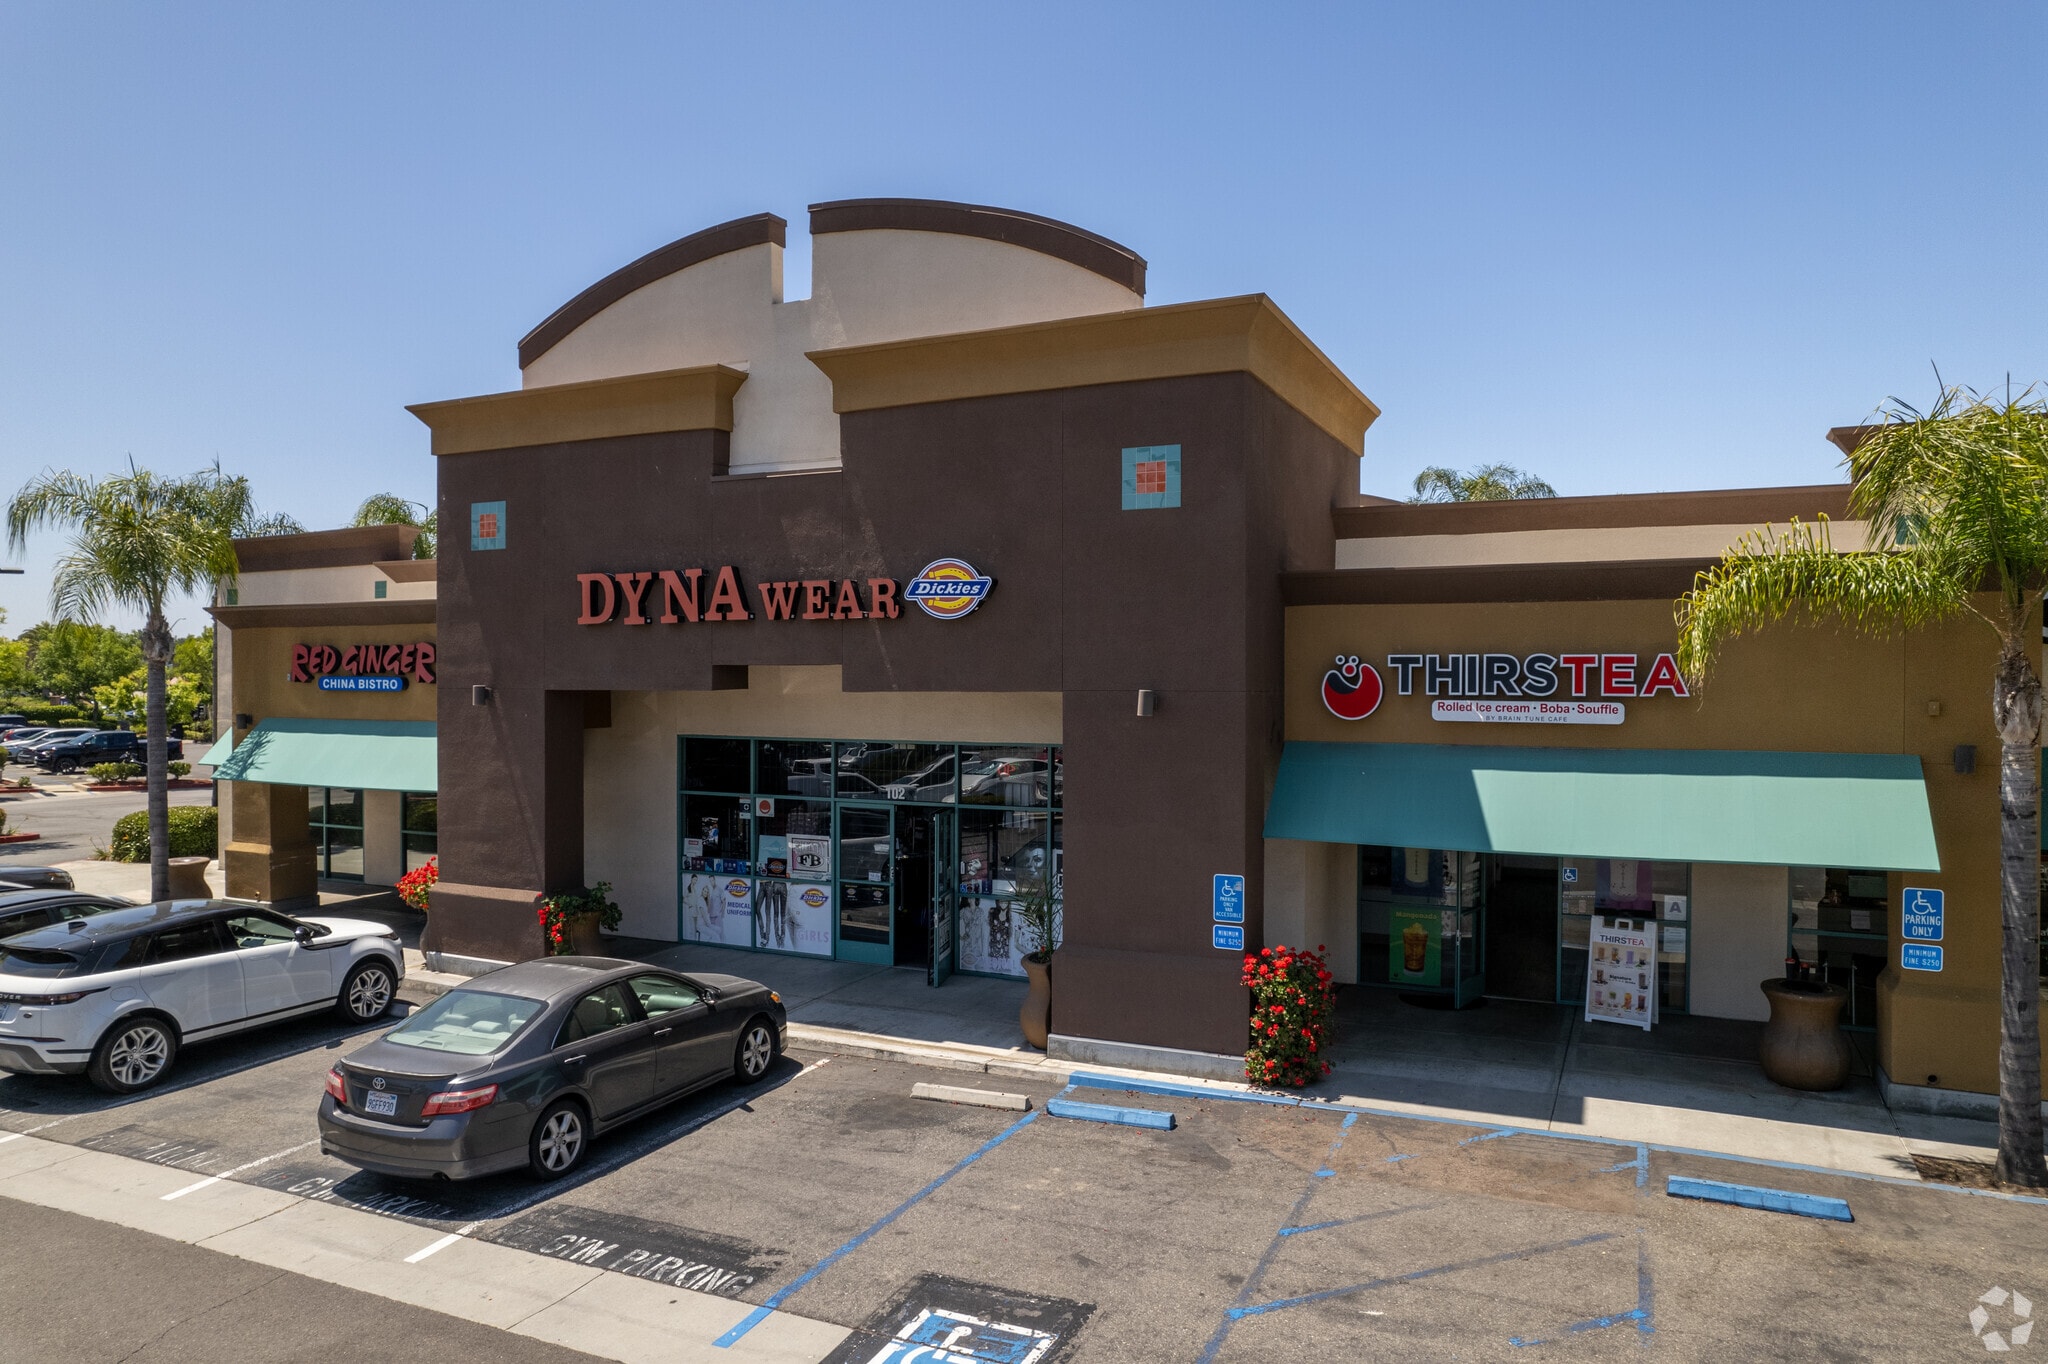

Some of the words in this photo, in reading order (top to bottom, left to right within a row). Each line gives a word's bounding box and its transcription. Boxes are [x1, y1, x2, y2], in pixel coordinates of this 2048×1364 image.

[577, 565, 749, 625] DYNA
[758, 577, 900, 620] WEAR
[915, 581, 982, 596] Dickies
[292, 643, 336, 682] RED
[341, 642, 435, 683] GINGER
[1387, 653, 1690, 698] THIRSTEA
[322, 678, 355, 689] CHINA
[358, 679, 398, 690] BISTRO
[1437, 701, 1472, 713] Rolled
[1475, 702, 1492, 713] Ice
[1495, 704, 1530, 714] cream
[1540, 703, 1570, 714] Boba
[1577, 703, 1619, 715] Souffle
[886, 788, 905, 800] 102
[727, 901, 751, 909] MEDICAL
[1669, 901, 1682, 913] A
[1905, 913, 1941, 926] PARKING
[798, 929, 829, 943] GIRLS
[1912, 926, 1933, 936] ONLY
[1600, 934, 1645, 946] THIRSTEA
[1908, 949, 1936, 957] MINIMUM
[540, 1234, 619, 1265] GYM
[622, 1248, 754, 1296] PARKING
